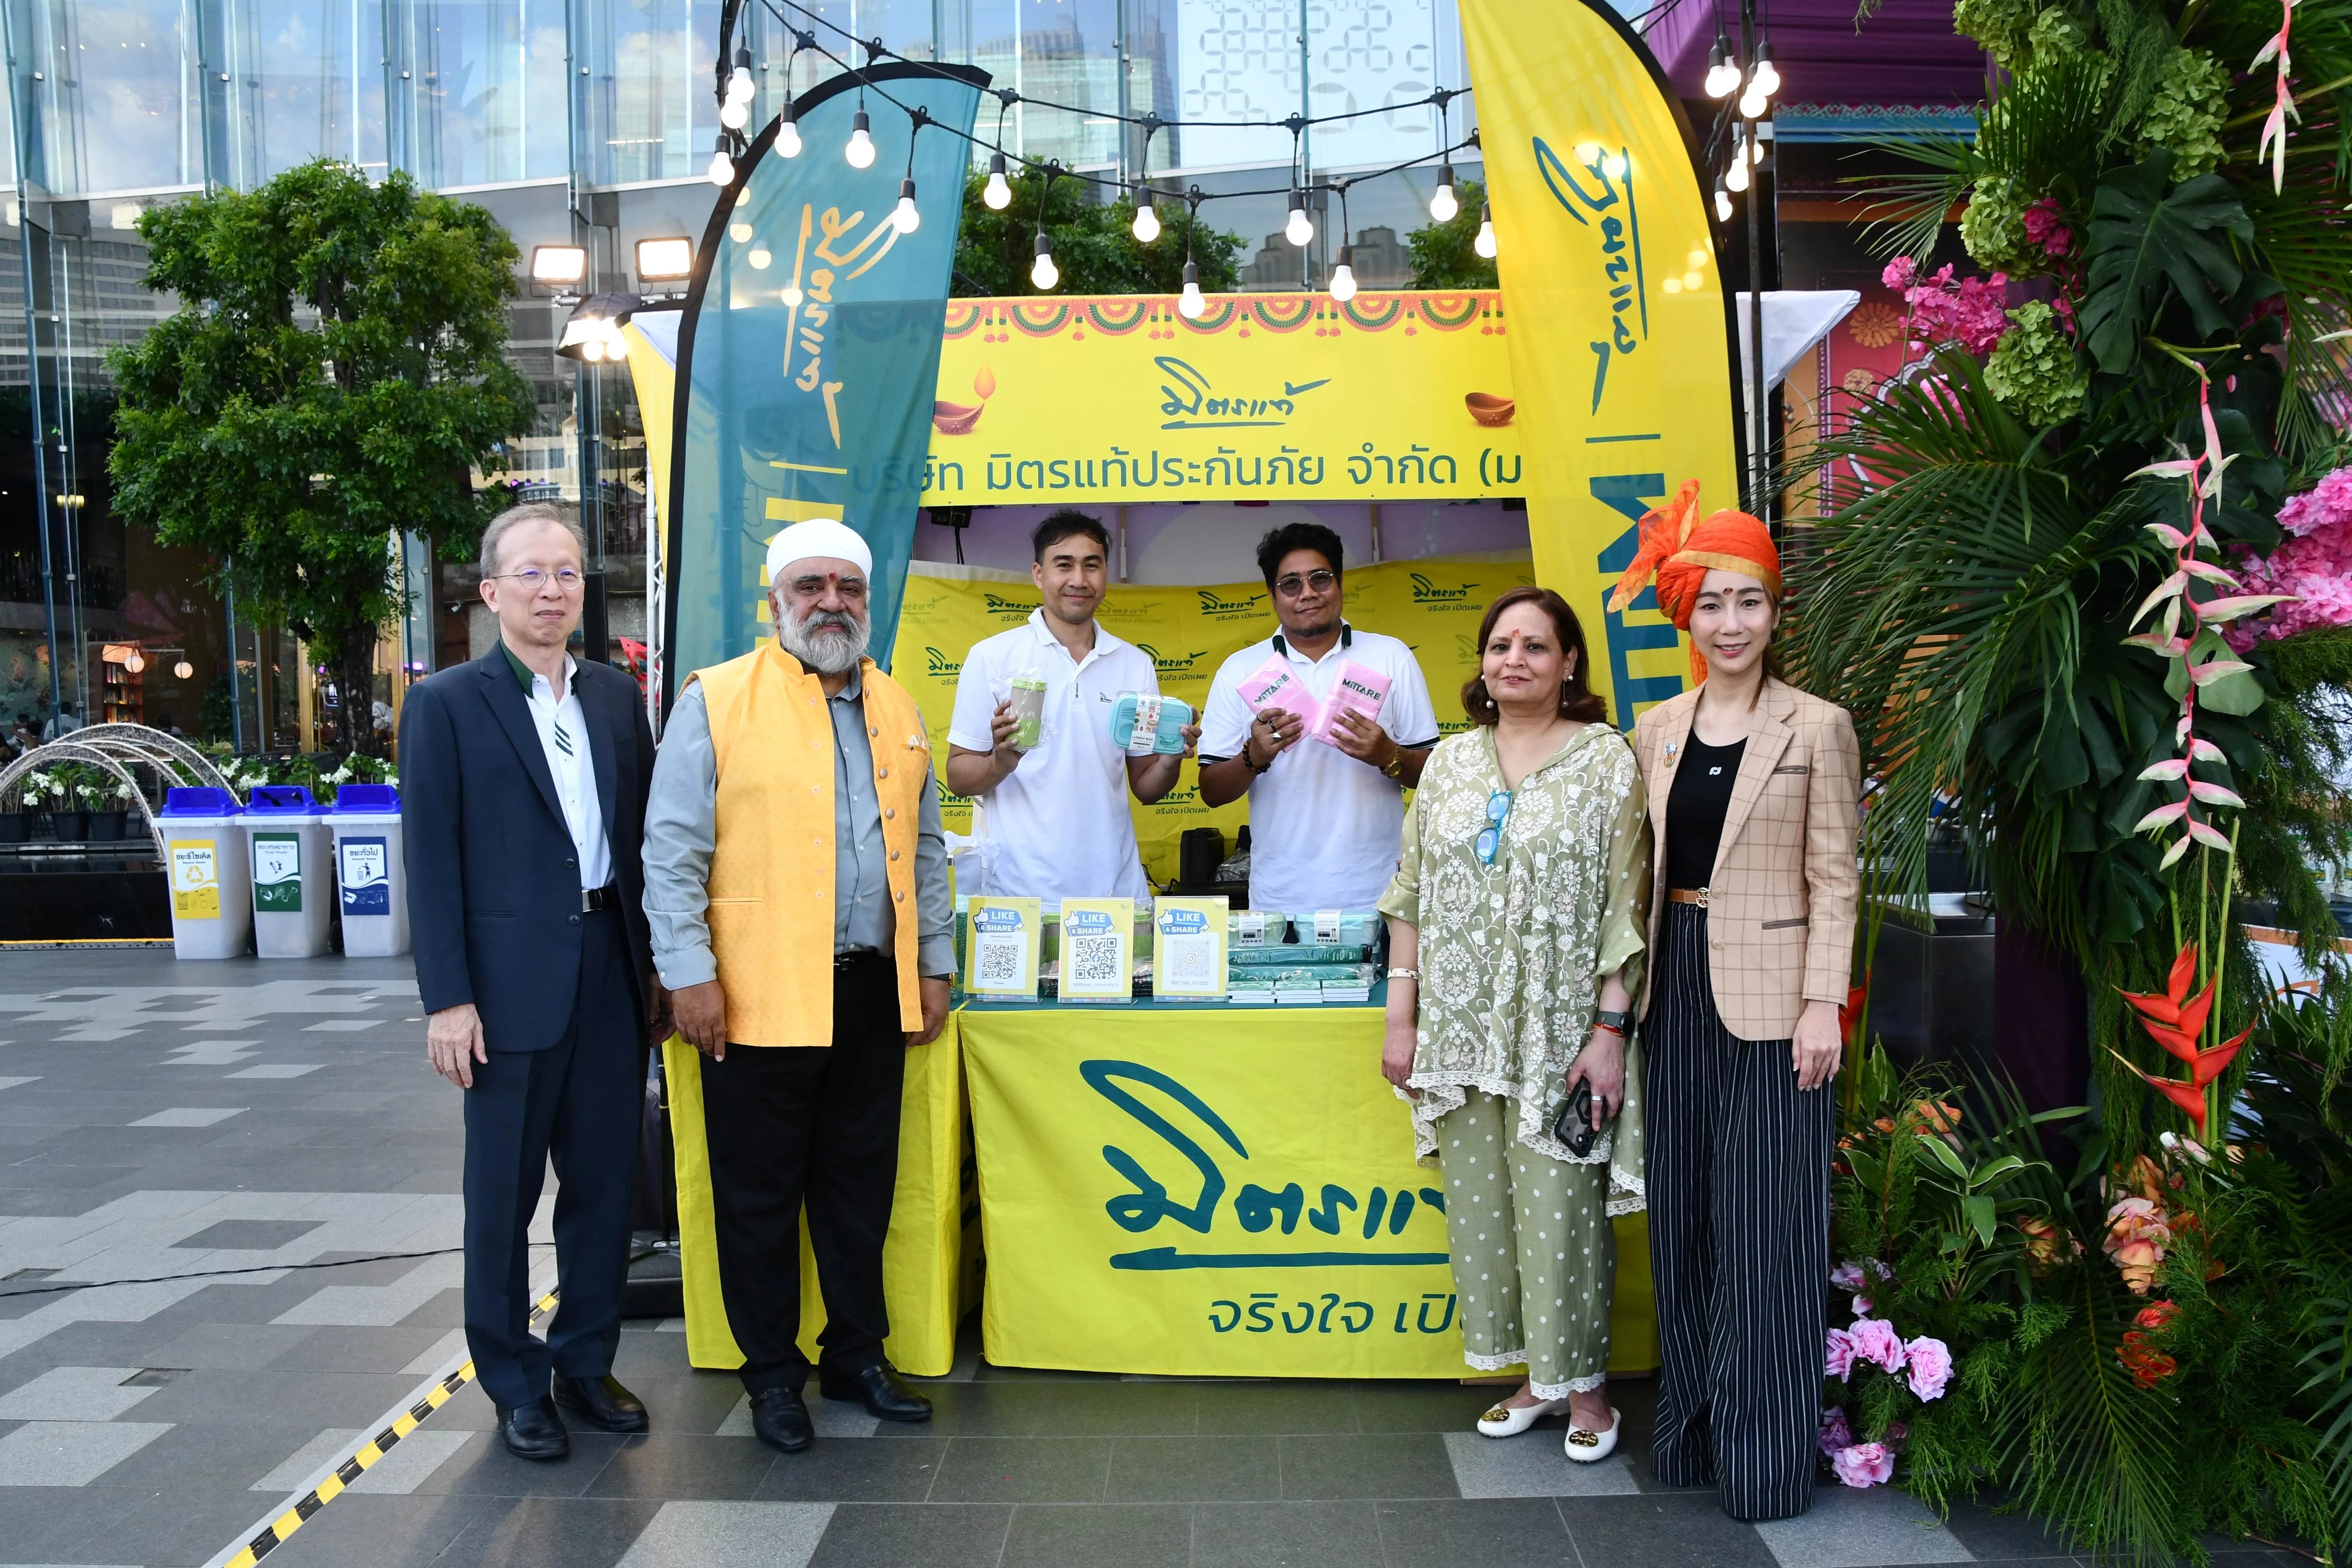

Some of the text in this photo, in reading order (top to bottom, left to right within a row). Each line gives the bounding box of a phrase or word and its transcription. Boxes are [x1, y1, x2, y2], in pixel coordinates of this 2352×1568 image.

[985, 447, 1324, 492] มิตรแท้ประกันภัย
[1346, 450, 1456, 485] จำกัด
[1427, 604, 1450, 612] จริงใจ
[1216, 611, 1271, 622] จริงใจ เปิดเผย
[176, 851, 211, 860] ขยะรีไซเคิล
[350, 846, 378, 856] ขยะทั่วไป
[991, 911, 1015, 920] LIKE
[1082, 914, 1105, 923] LIKE
[1176, 913, 1200, 922] LIKE
[1208, 1293, 1374, 1335] จริงใจ
